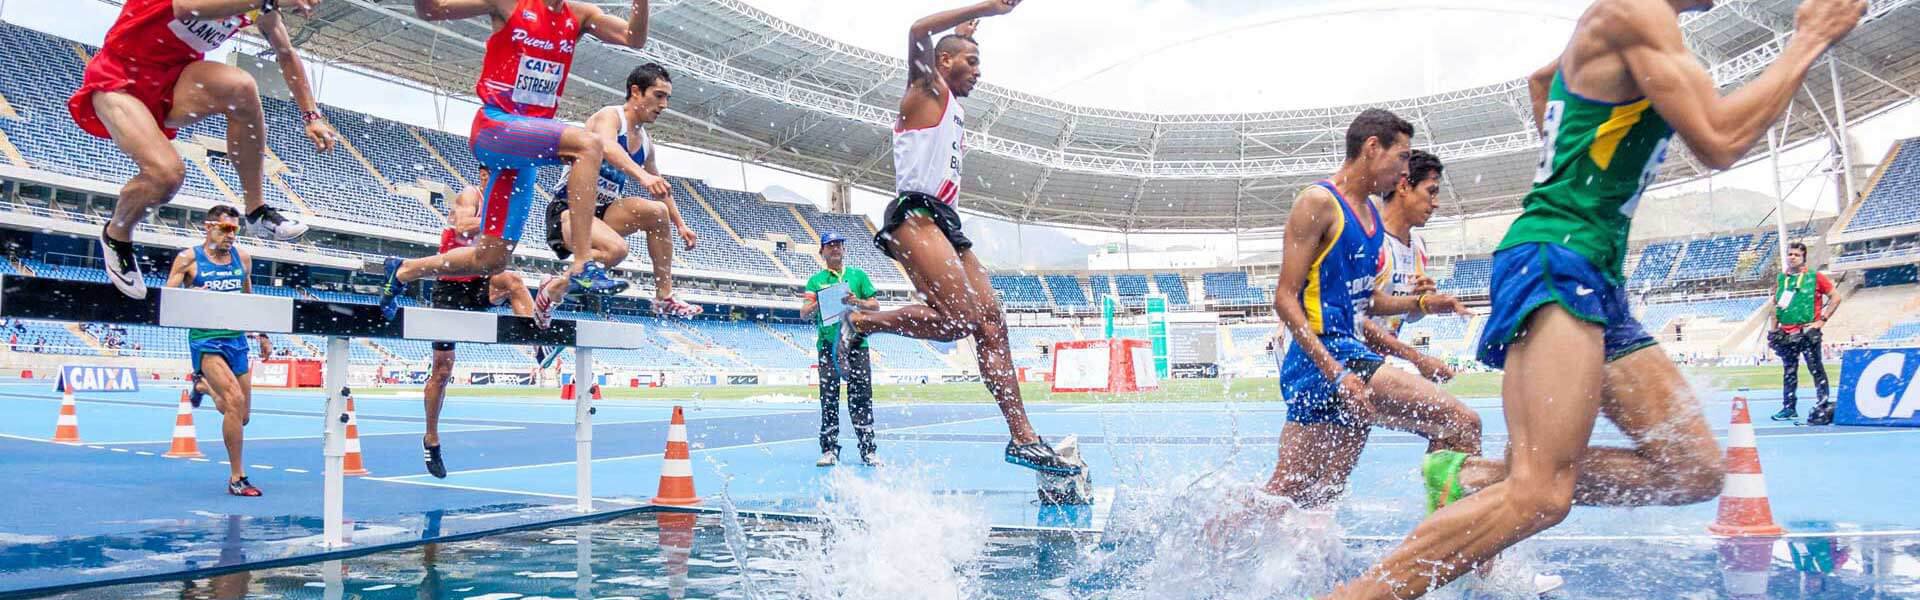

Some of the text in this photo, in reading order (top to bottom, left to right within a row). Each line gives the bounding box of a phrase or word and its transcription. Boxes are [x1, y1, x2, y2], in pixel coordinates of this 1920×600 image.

[512, 28, 554, 50] Puerto
[204, 279, 243, 290] BRASIL
[70, 367, 136, 390] CAIXA
